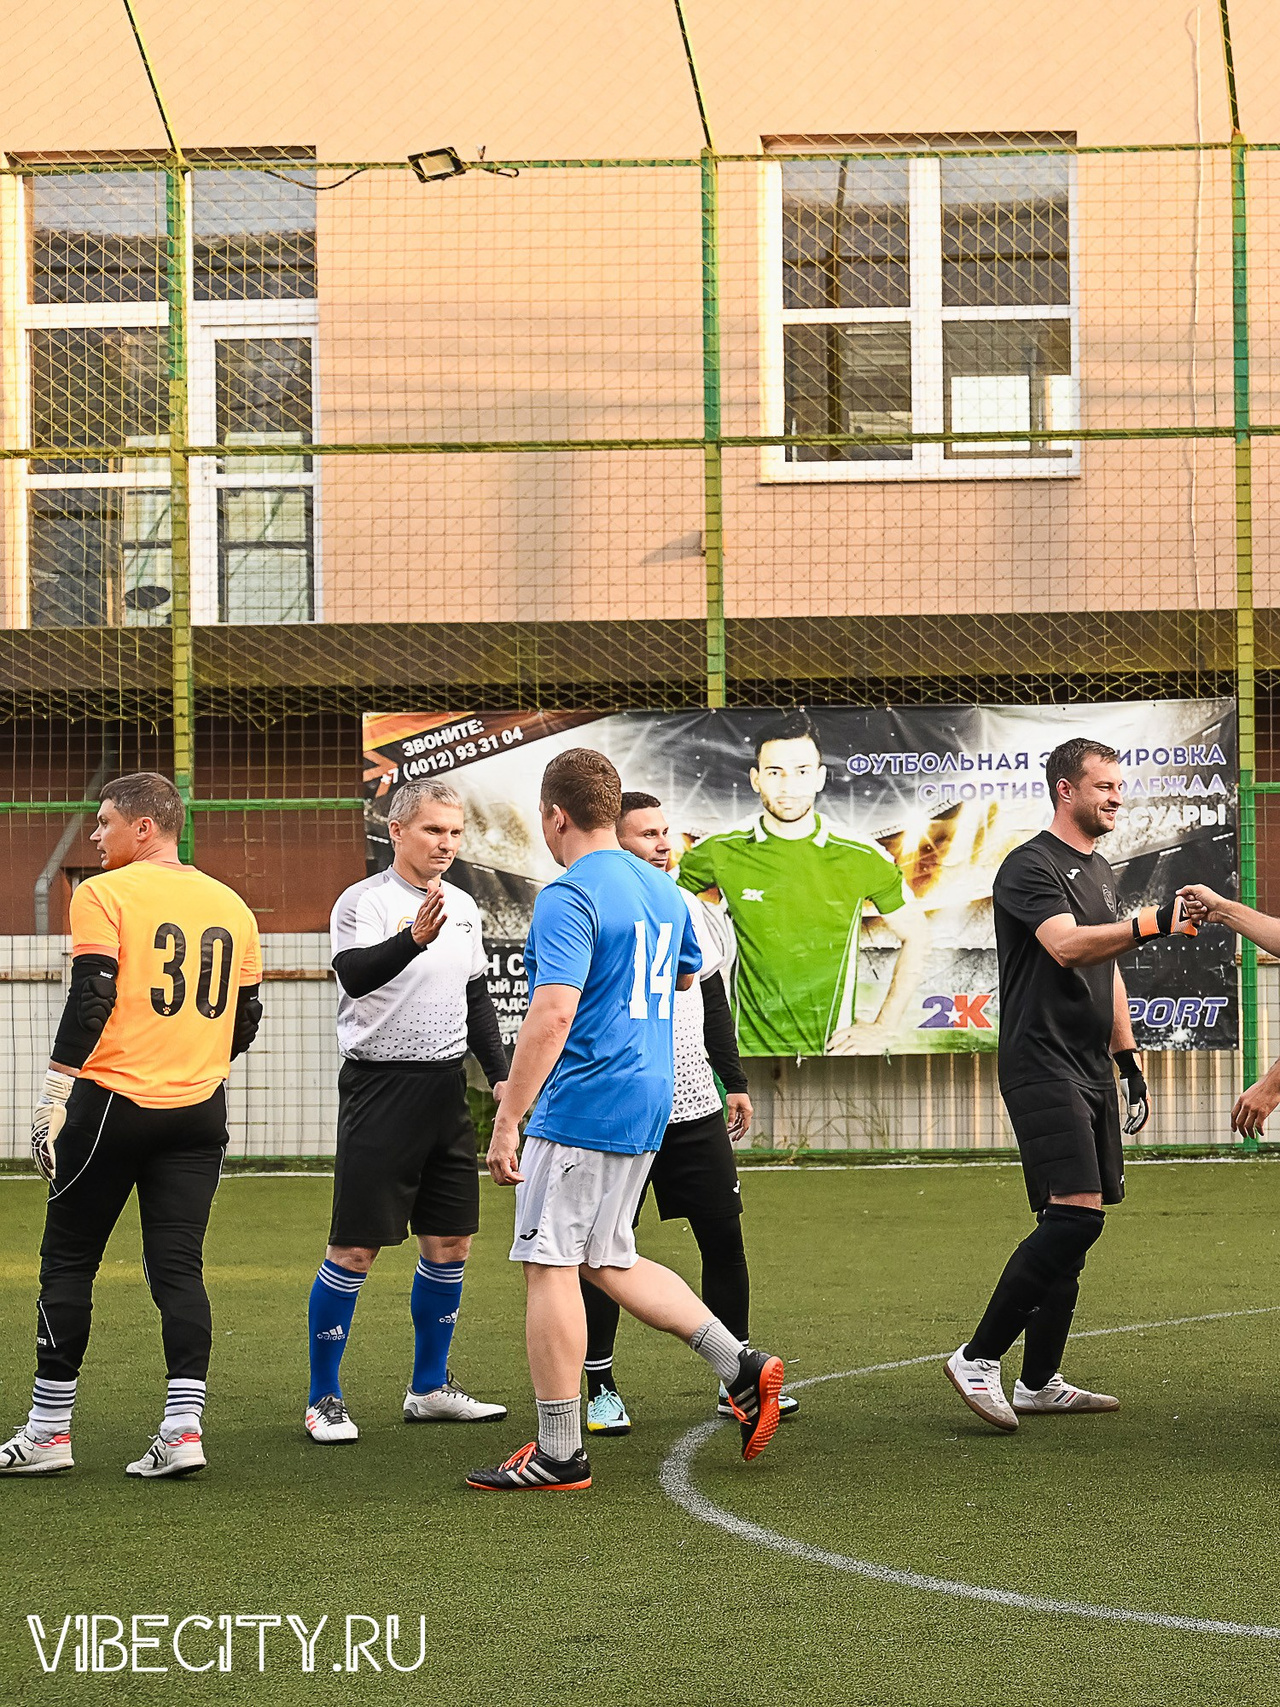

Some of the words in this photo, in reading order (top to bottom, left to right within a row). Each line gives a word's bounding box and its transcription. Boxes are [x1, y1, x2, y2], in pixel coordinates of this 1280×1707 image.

[380, 767, 399, 784] +7
[402, 749, 455, 781] (4012)
[455, 742, 477, 761] 93
[477, 734, 499, 752] 31
[501, 726, 524, 744] 04
[401, 719, 485, 757] ЗВОНИТЕ:
[847, 752, 1029, 775] ФУТБОЛЬНАЯ
[919, 781, 1045, 801] СПОРТИВ
[150, 922, 234, 1019] 30
[628, 920, 673, 1019] 14
[916, 993, 994, 1029] 2K
[1128, 996, 1229, 1028] PORT
